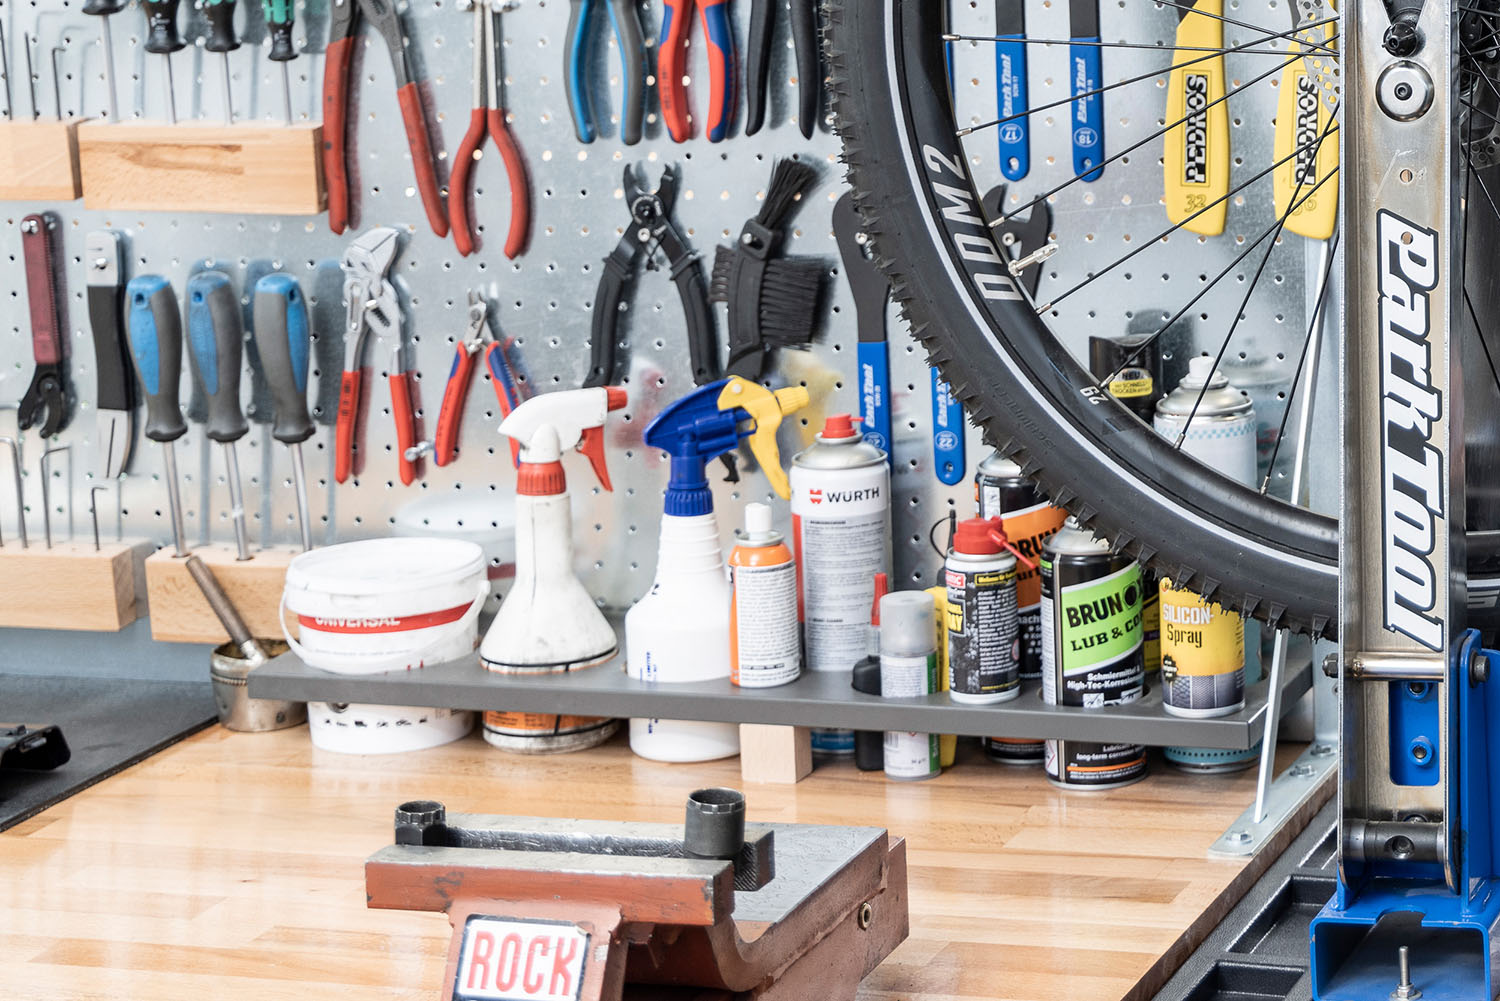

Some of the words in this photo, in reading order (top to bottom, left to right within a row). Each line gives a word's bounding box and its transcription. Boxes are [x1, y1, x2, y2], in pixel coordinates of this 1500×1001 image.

[1185, 75, 1207, 183] PEDRO'S
[925, 143, 1024, 300] DDM2
[827, 486, 880, 504] WÜRTH
[1162, 603, 1214, 625] SILICON-
[1070, 632, 1108, 651] LUB
[1111, 626, 1123, 639] &
[1167, 624, 1203, 649] Spray
[466, 930, 579, 997] ROCK
